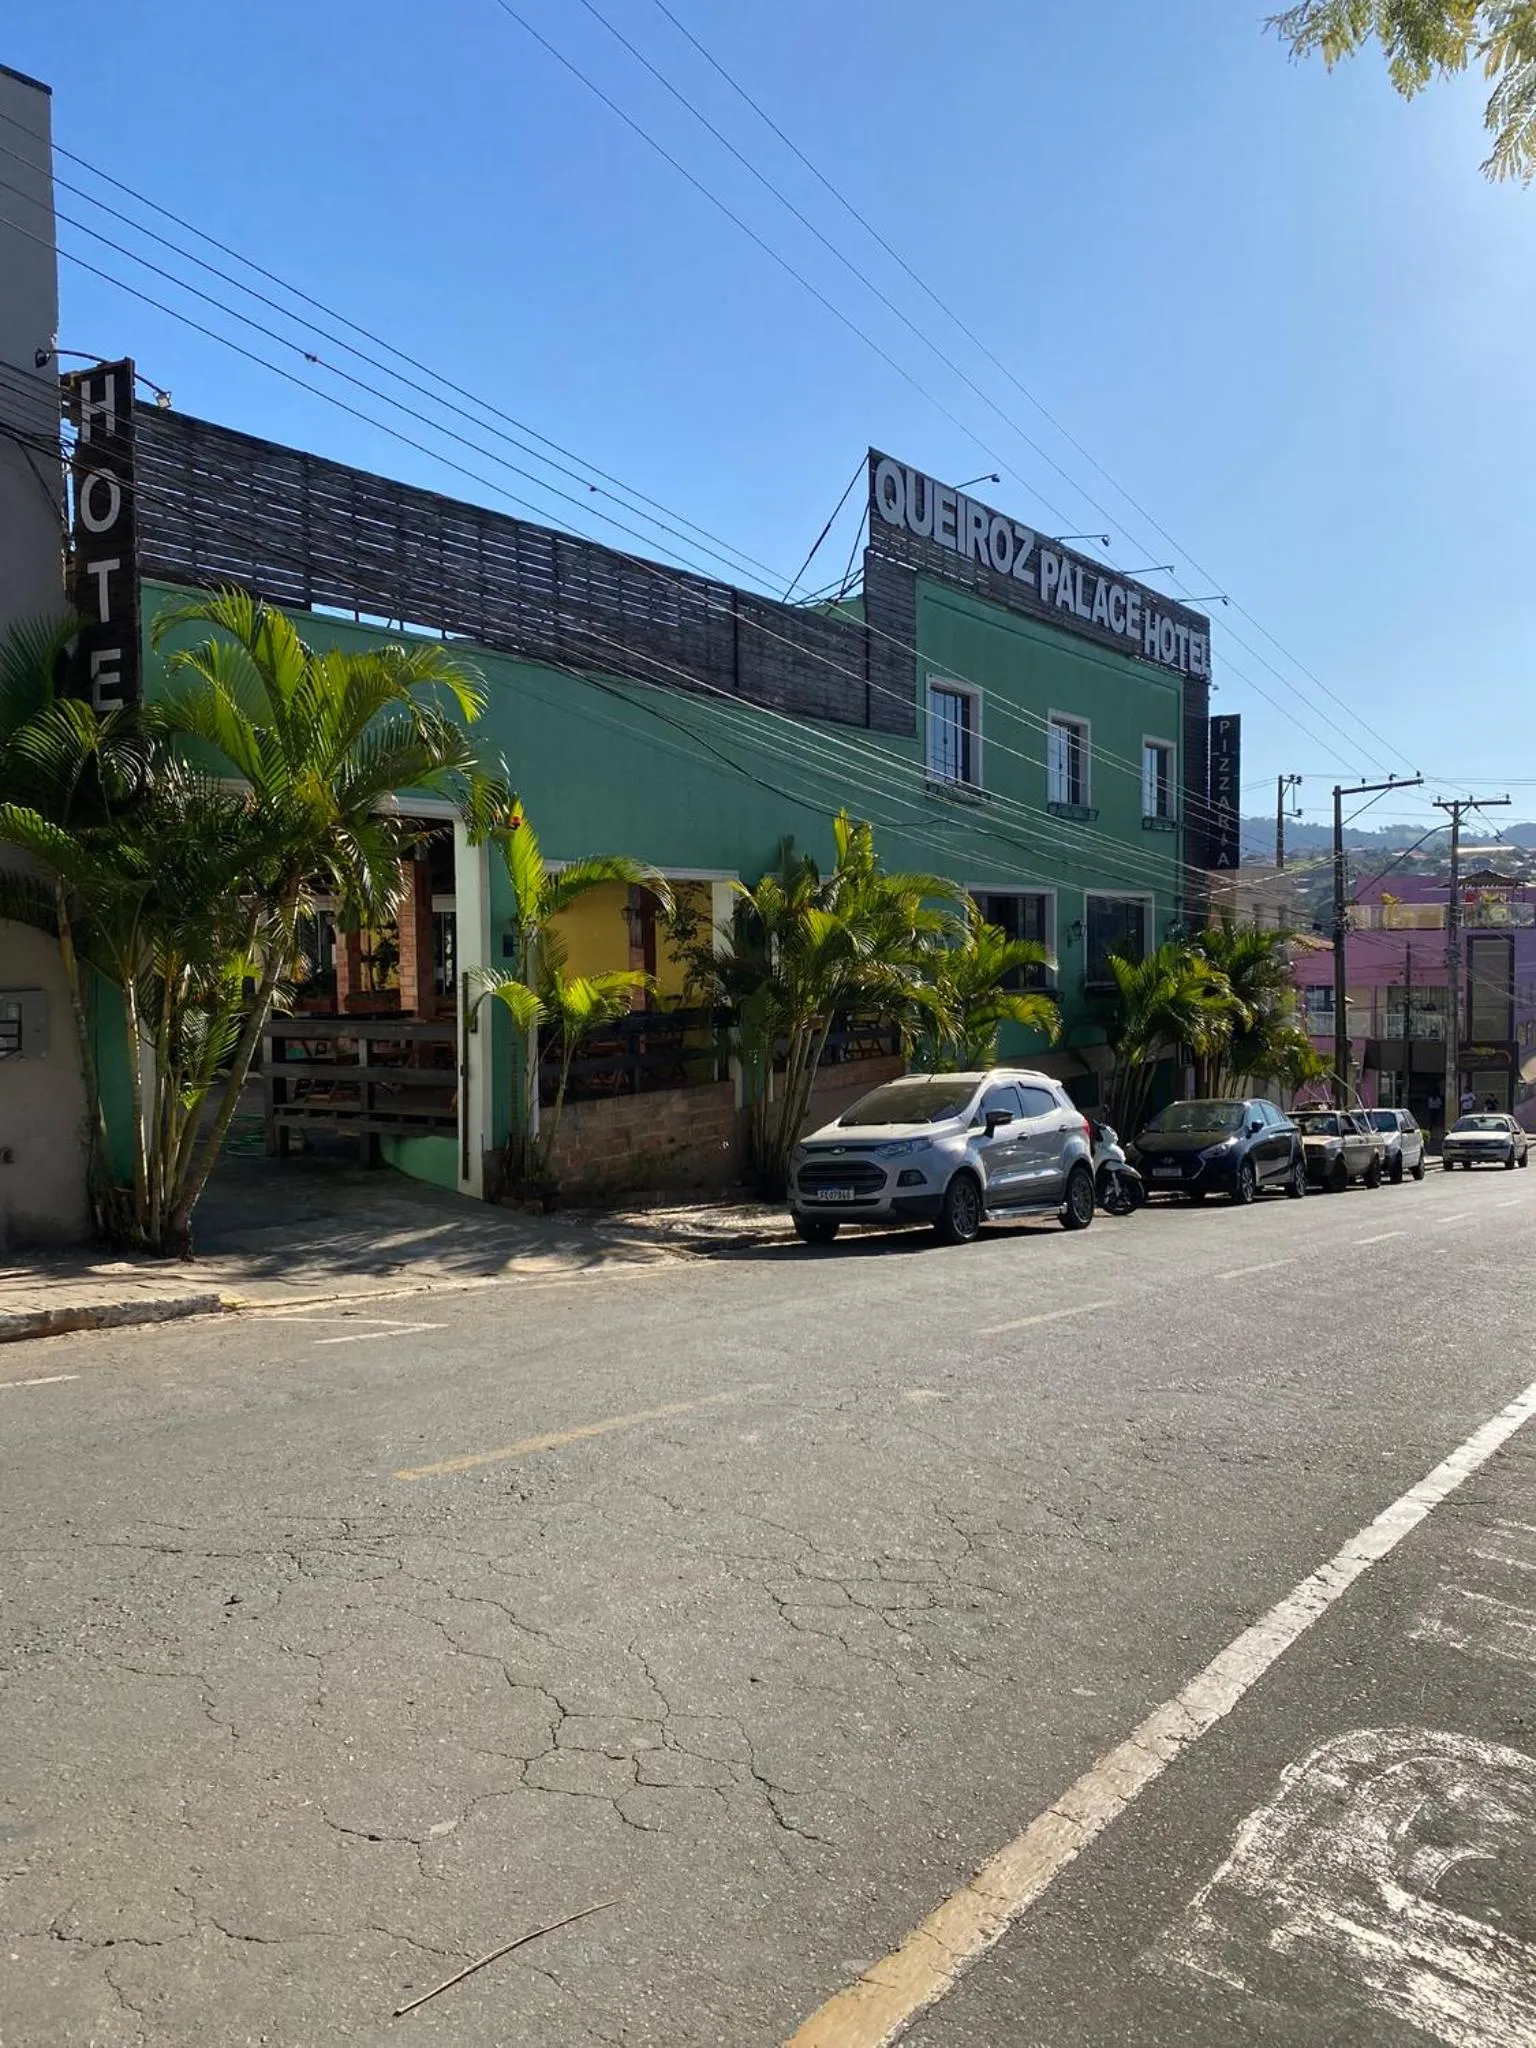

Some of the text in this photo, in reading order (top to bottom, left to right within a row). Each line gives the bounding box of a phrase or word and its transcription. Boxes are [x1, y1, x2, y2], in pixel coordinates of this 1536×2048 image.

[80, 373, 124, 712] HOTE
[875, 458, 1211, 680] QUEIROZ PALACE HOTEL
[1217, 720, 1231, 866] PIZZARIA
